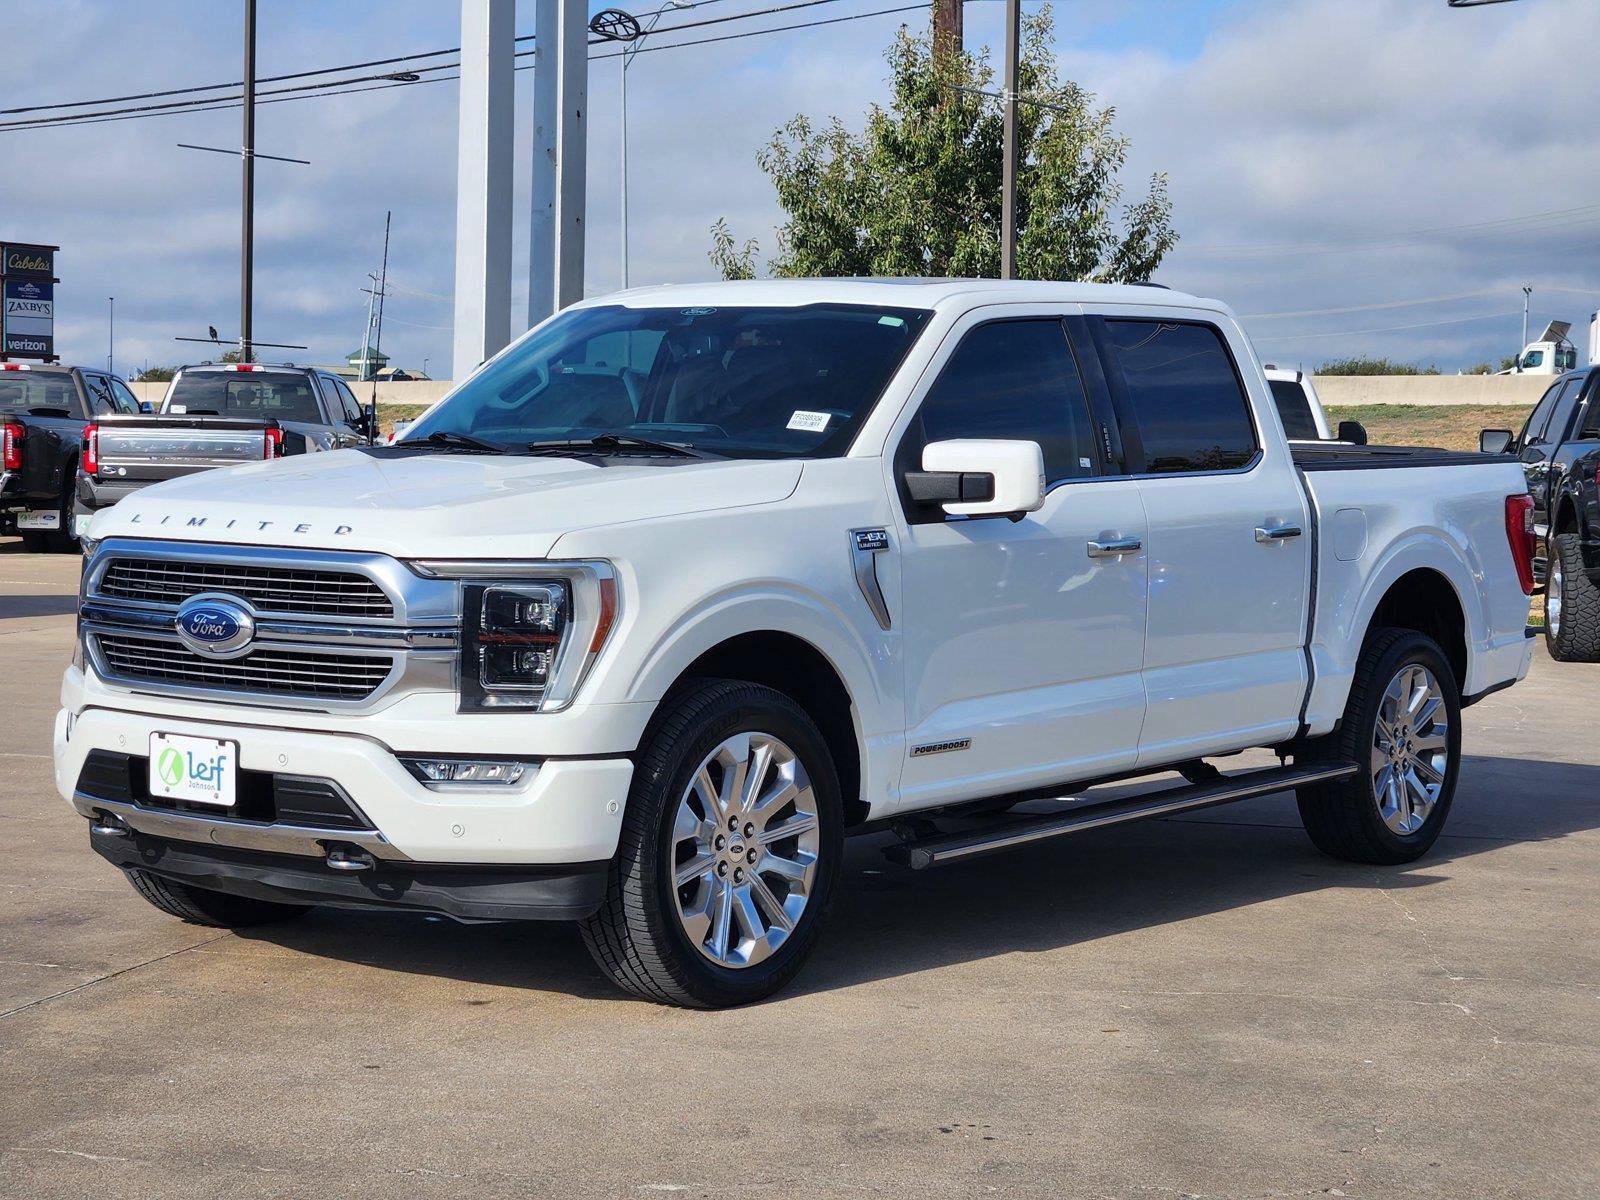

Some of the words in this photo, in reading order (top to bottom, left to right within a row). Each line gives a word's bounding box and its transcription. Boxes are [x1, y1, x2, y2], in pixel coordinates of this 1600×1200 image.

[8, 301, 51, 314] ZAXBY'S
[8, 339, 46, 350] verizon
[131, 513, 353, 536] LIMITED
[857, 531, 887, 543] F-150
[859, 541, 882, 549] LIMITED
[190, 612, 227, 637] Ford
[914, 739, 971, 755] POWERBOOST
[188, 780, 216, 791] Johnson
